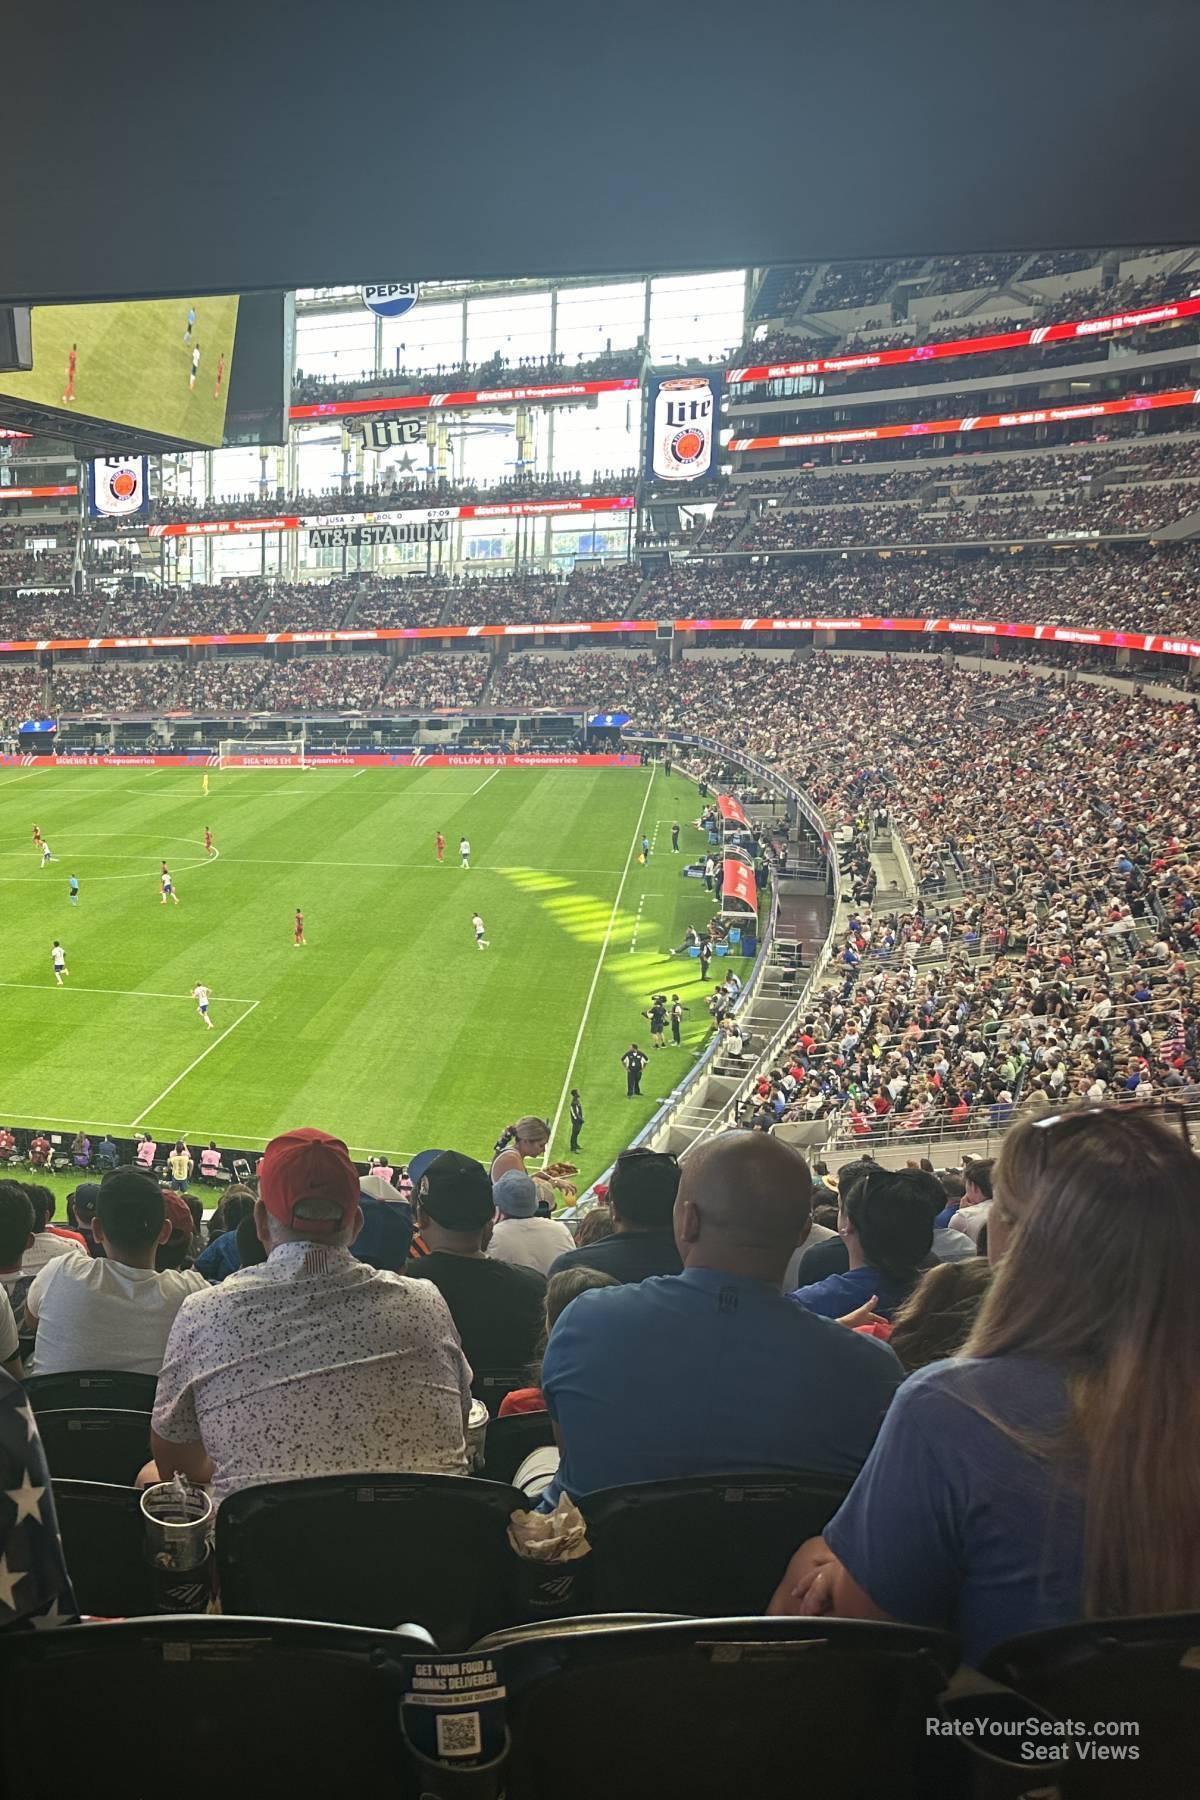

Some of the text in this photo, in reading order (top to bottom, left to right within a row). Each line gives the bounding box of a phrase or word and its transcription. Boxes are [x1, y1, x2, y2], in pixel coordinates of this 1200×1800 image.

[365, 283, 415, 298] PEPSI
[666, 400, 711, 428] Lite
[361, 420, 420, 452] Lite
[427, 509, 450, 518] 67:09
[310, 523, 448, 548] AT&T STADIUM
[103, 756, 155, 766] @copaamerica
[449, 756, 578, 766] FOLLOW US AT @copaamerica
[415, 1663, 432, 1676] GET
[434, 1662, 460, 1676] YOUR
[461, 1660, 484, 1675] FOOD
[412, 1676, 447, 1690] DRINKS
